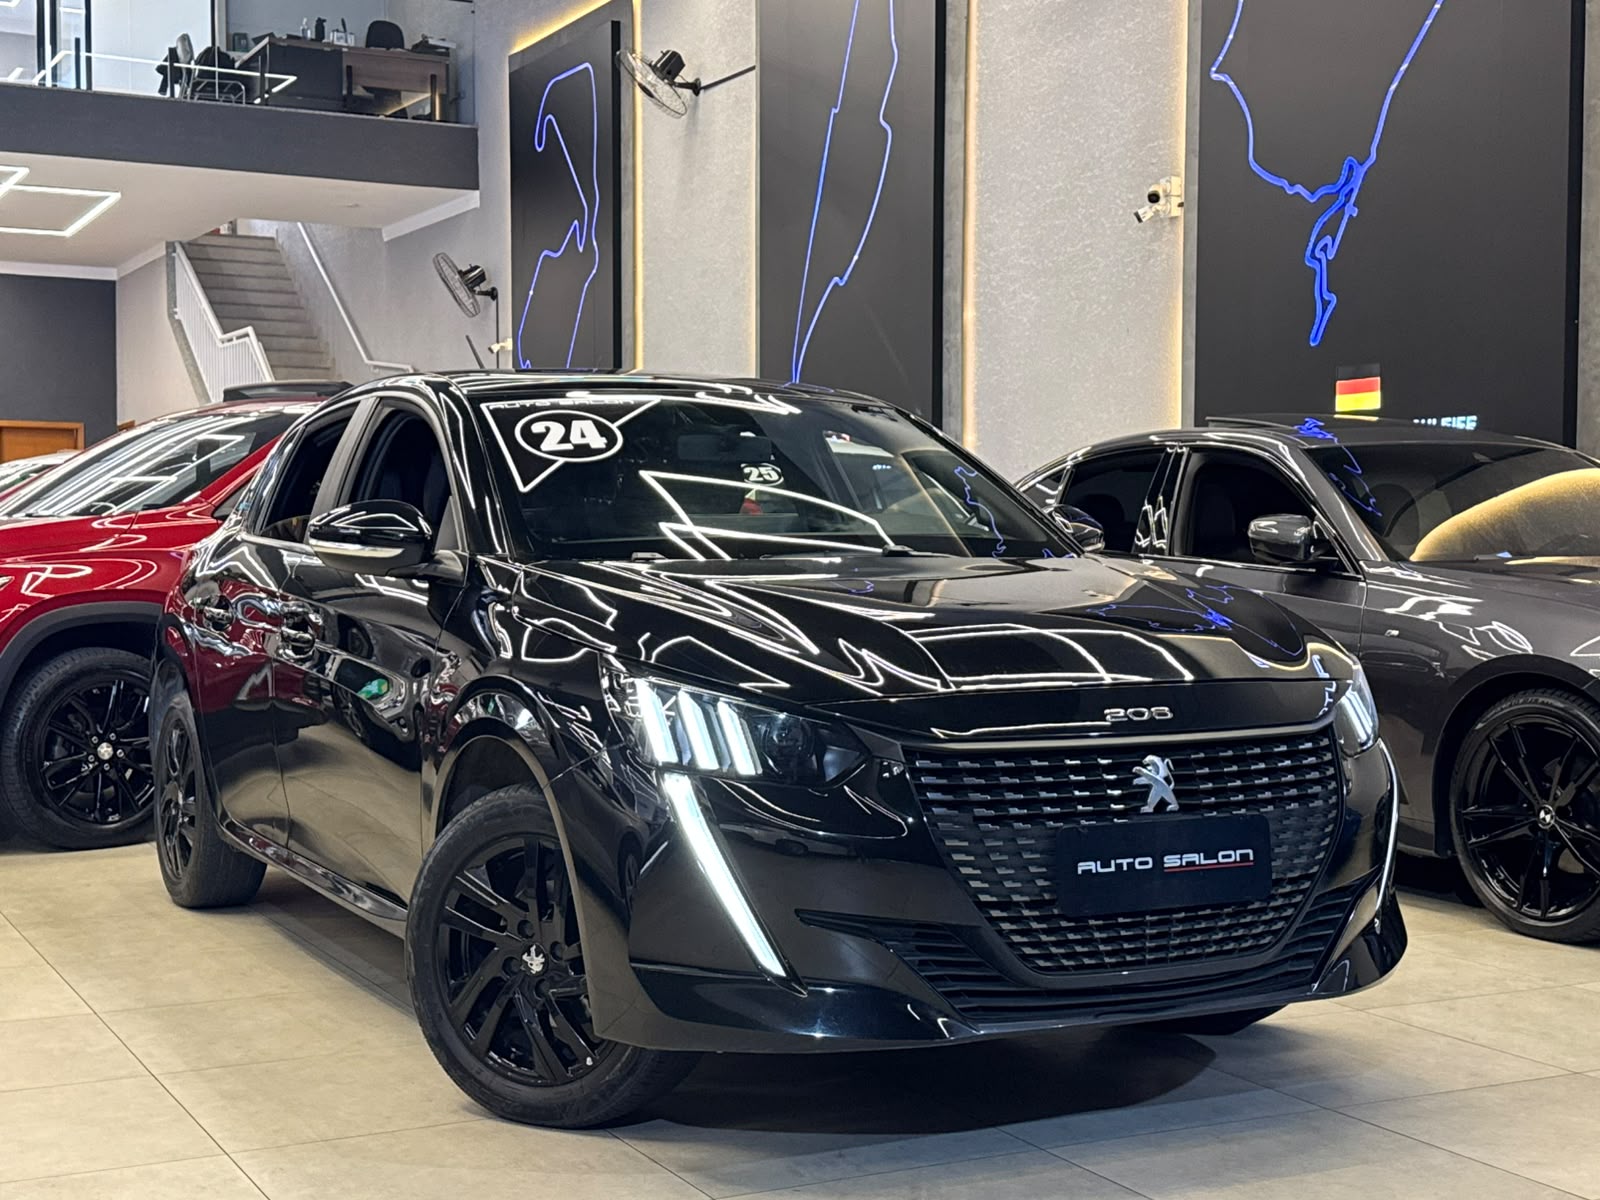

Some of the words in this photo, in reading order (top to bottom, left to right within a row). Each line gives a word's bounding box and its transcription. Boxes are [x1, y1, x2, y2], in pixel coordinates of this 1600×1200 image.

[530, 420, 608, 452] 24
[743, 466, 779, 481] 25
[1103, 706, 1174, 722] 208
[1077, 856, 1153, 875] AUTO
[1163, 848, 1254, 868] SALON
